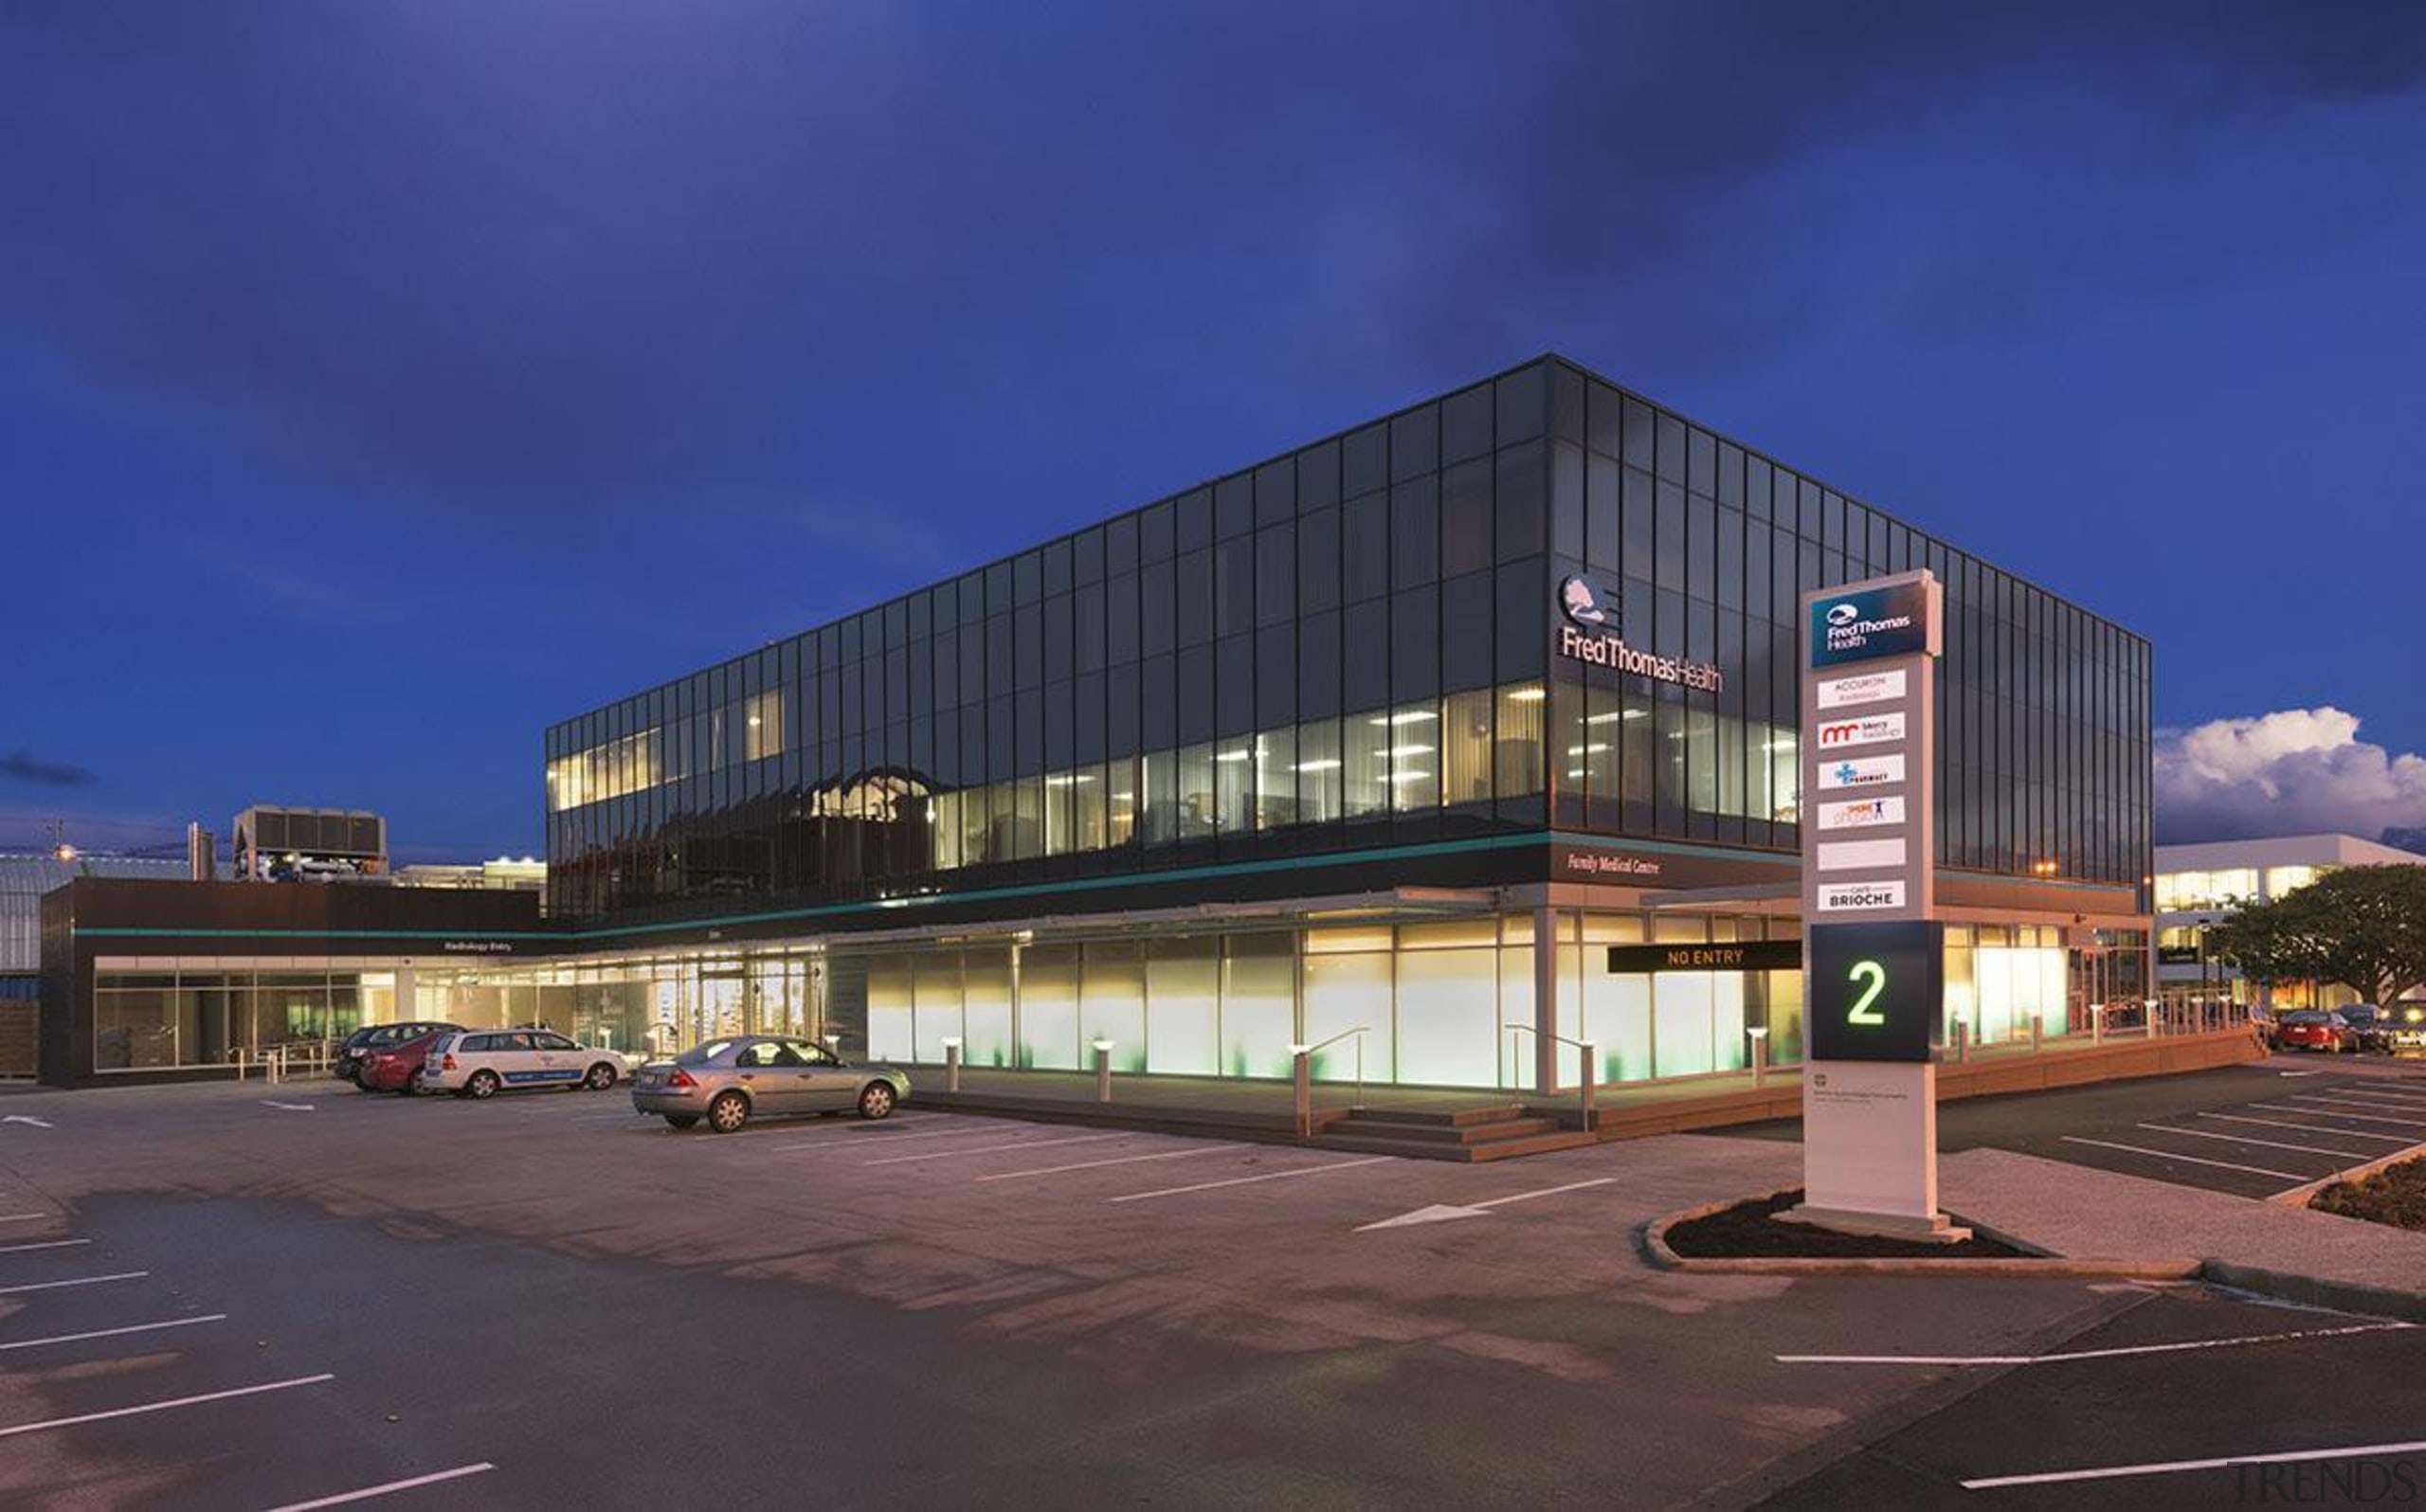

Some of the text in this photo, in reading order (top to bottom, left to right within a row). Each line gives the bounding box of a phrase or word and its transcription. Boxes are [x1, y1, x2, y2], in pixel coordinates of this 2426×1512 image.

[1567, 853, 1598, 873] Family
[1599, 855, 1632, 873] Medical
[1830, 892, 1893, 907] BRIOCHE
[1669, 949, 1744, 965] NO ENTRY
[1847, 960, 1886, 1025] 2
